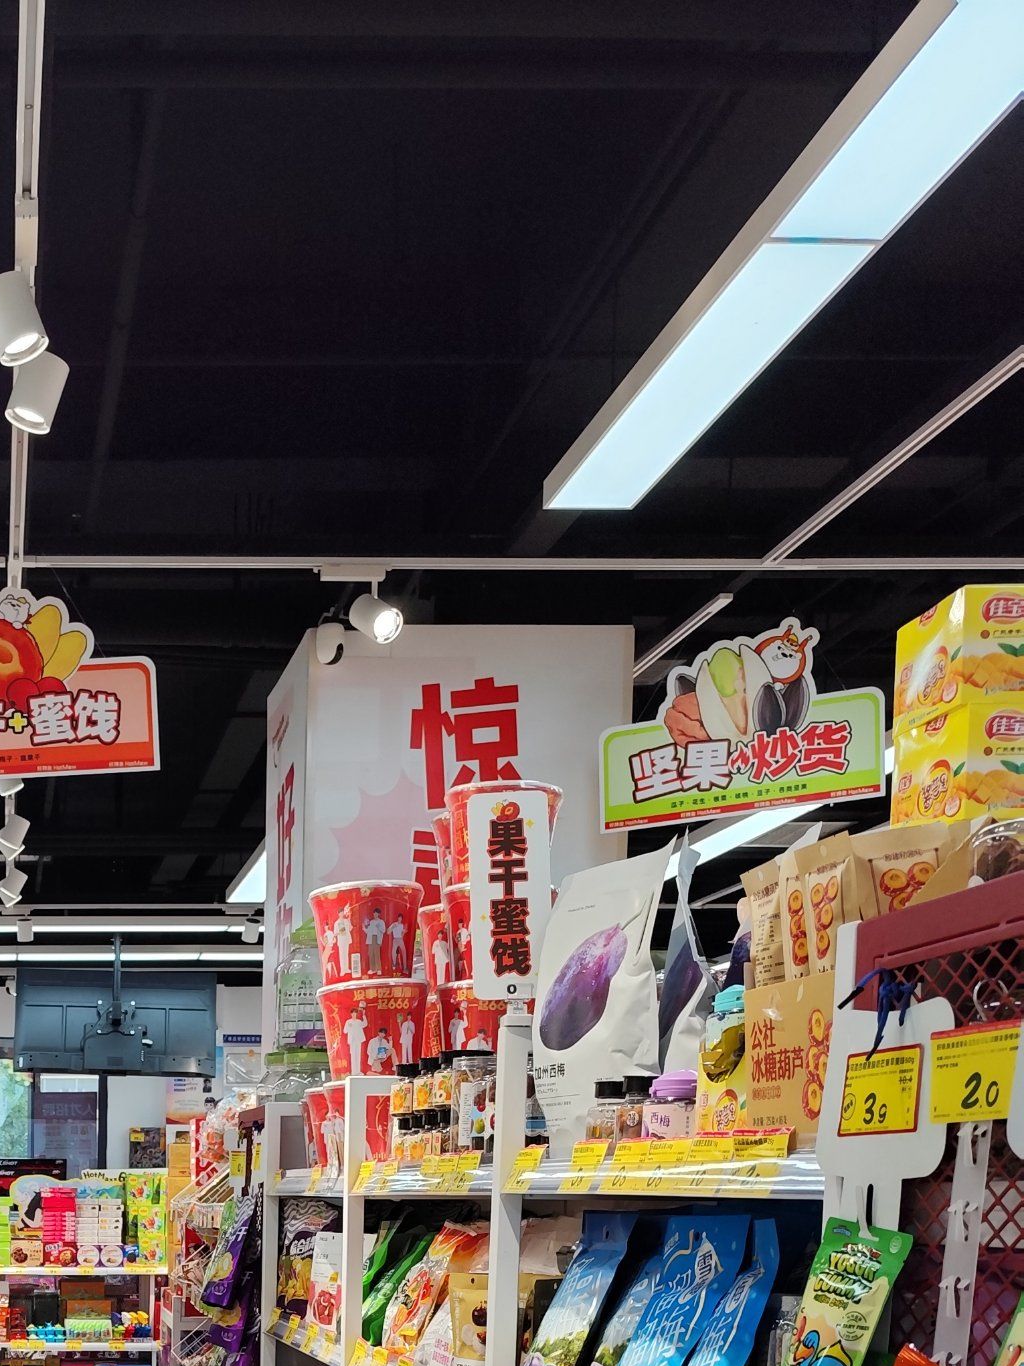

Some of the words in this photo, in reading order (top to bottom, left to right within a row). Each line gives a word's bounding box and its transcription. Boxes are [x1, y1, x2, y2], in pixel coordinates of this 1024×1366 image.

[410, 677, 522, 810] 惊
[631, 721, 852, 803] 坚果炒货
[487, 817, 532, 977] 果干蜜饯
[750, 1018, 777, 1050] 公社
[751, 1045, 804, 1084] 冰糖葫芦
[862, 1092, 888, 1126] 3.9
[961, 1071, 1000, 1110] 2.0
[650, 1112, 671, 1128] 西梅
